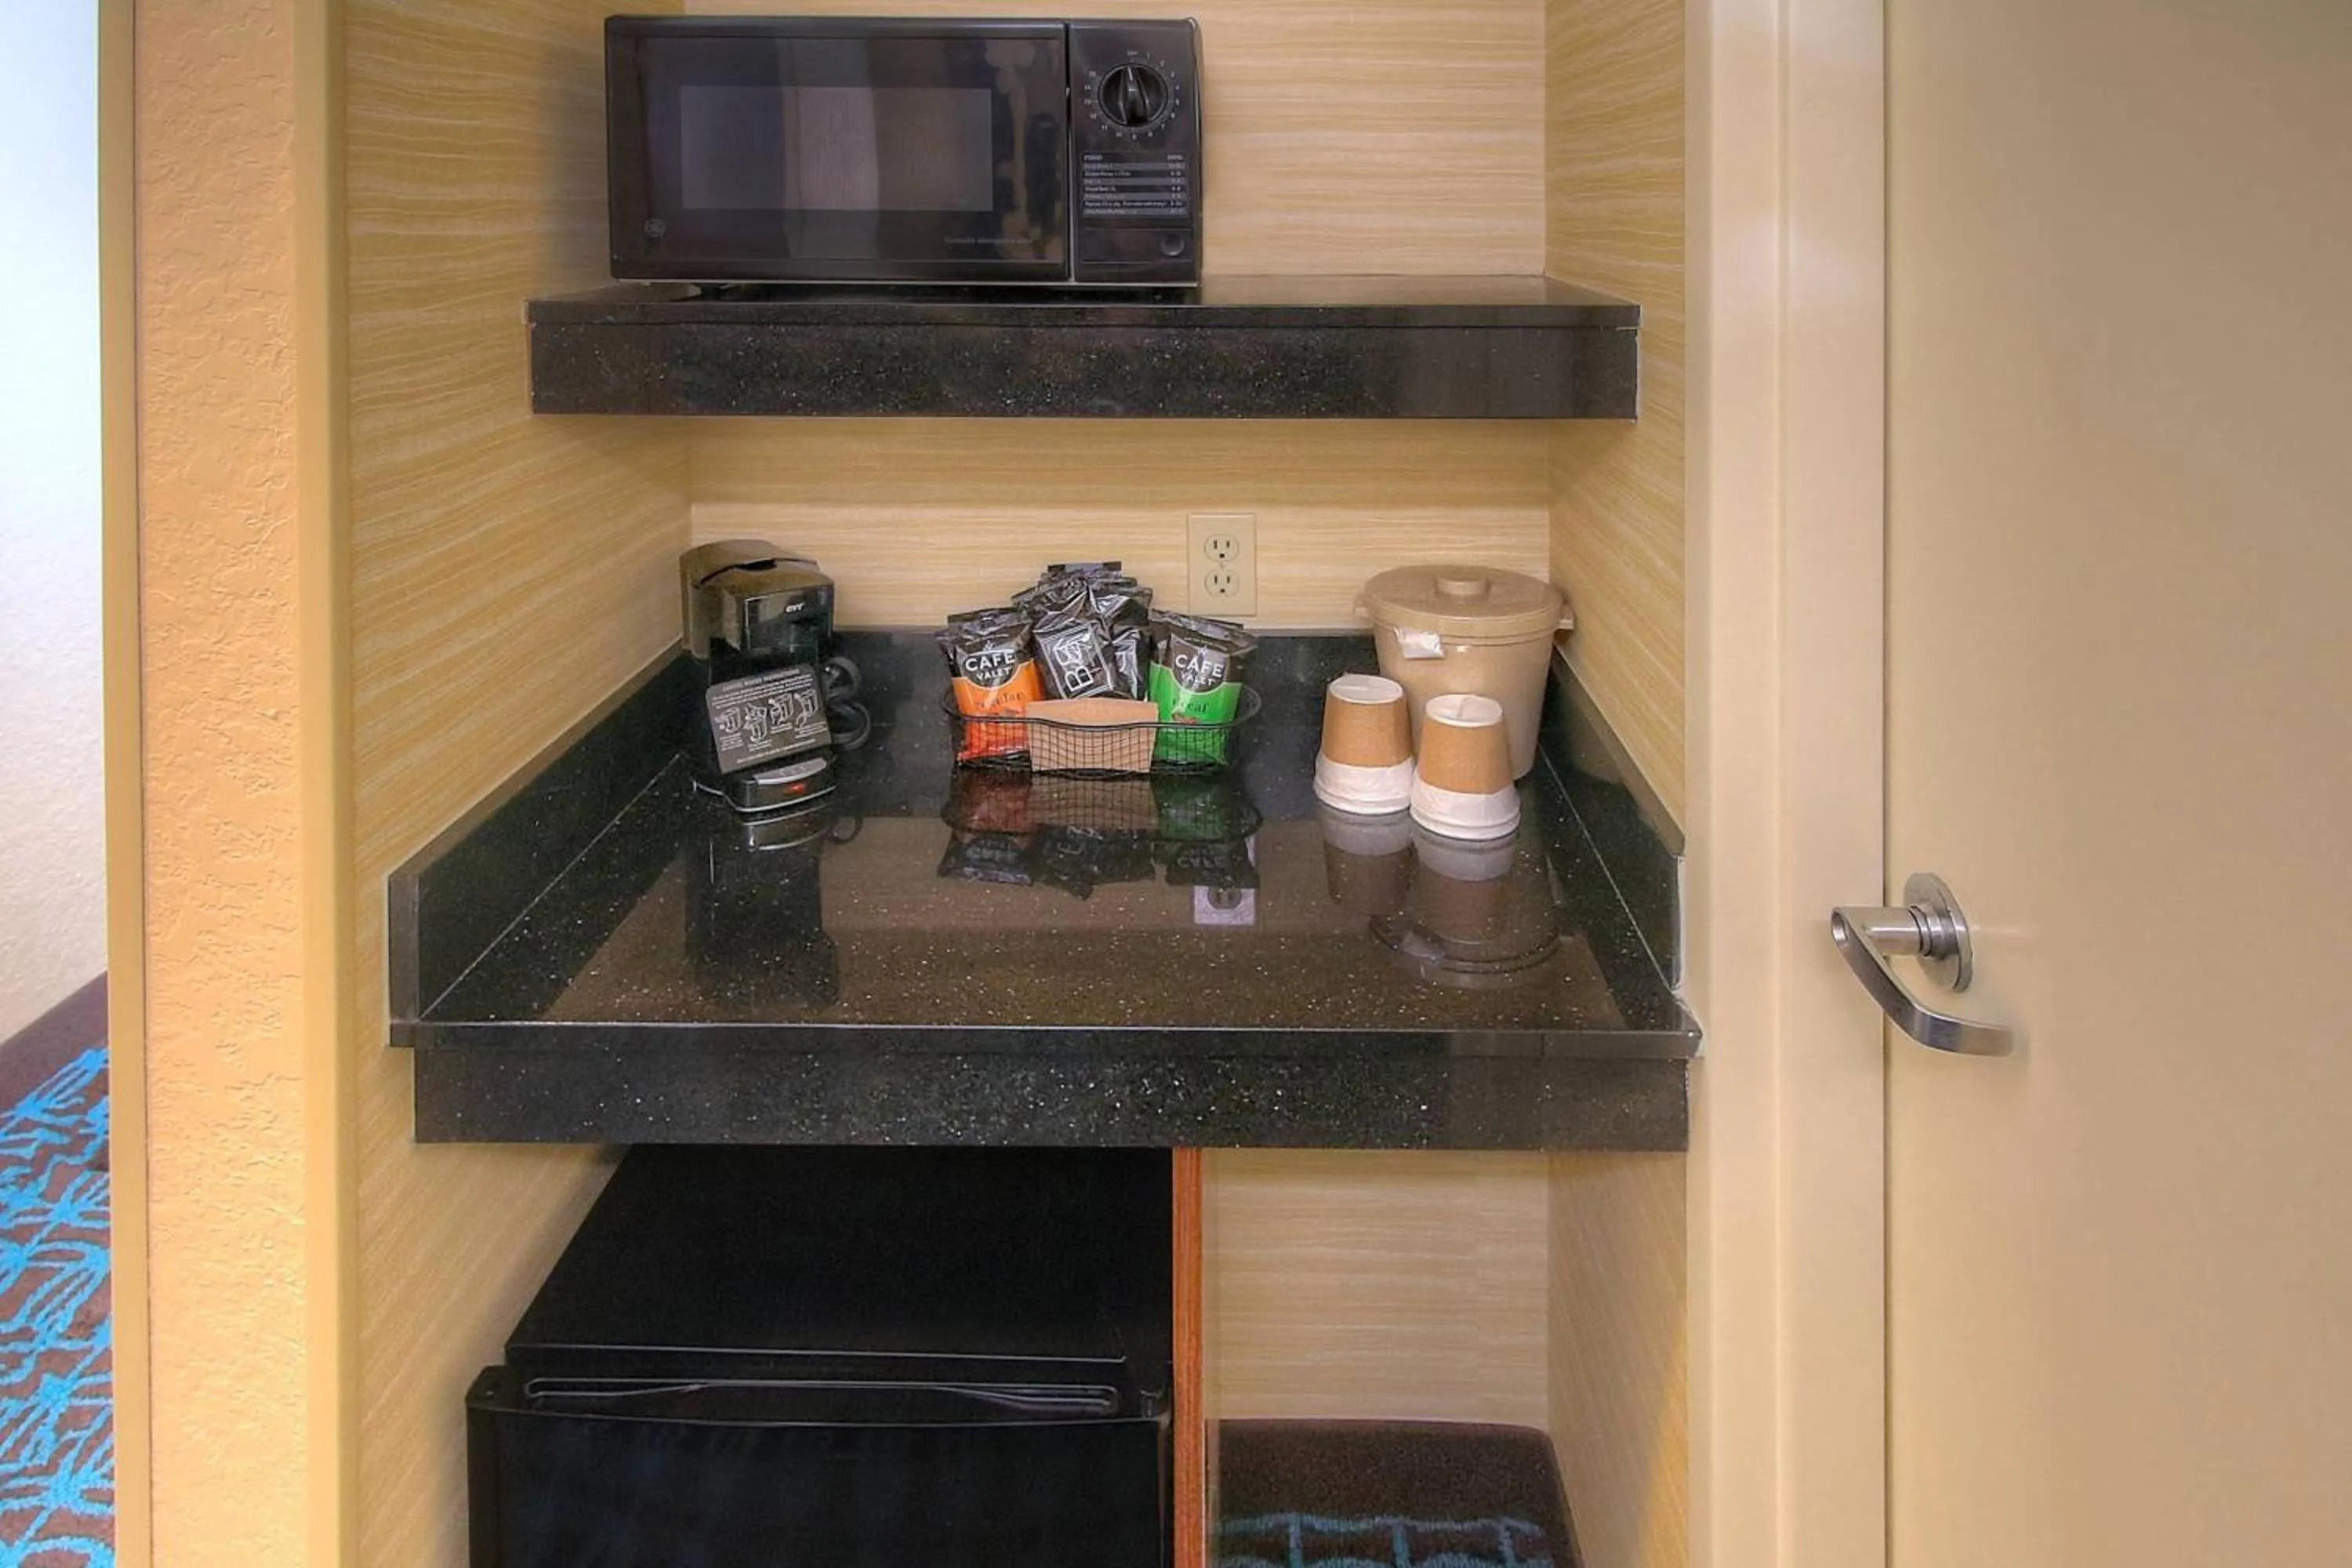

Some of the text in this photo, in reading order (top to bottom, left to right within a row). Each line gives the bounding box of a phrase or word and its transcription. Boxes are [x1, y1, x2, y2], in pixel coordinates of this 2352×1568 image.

[965, 652, 1016, 672] CAFE
[1175, 654, 1224, 678] CAFE
[976, 666, 1011, 681] VALET
